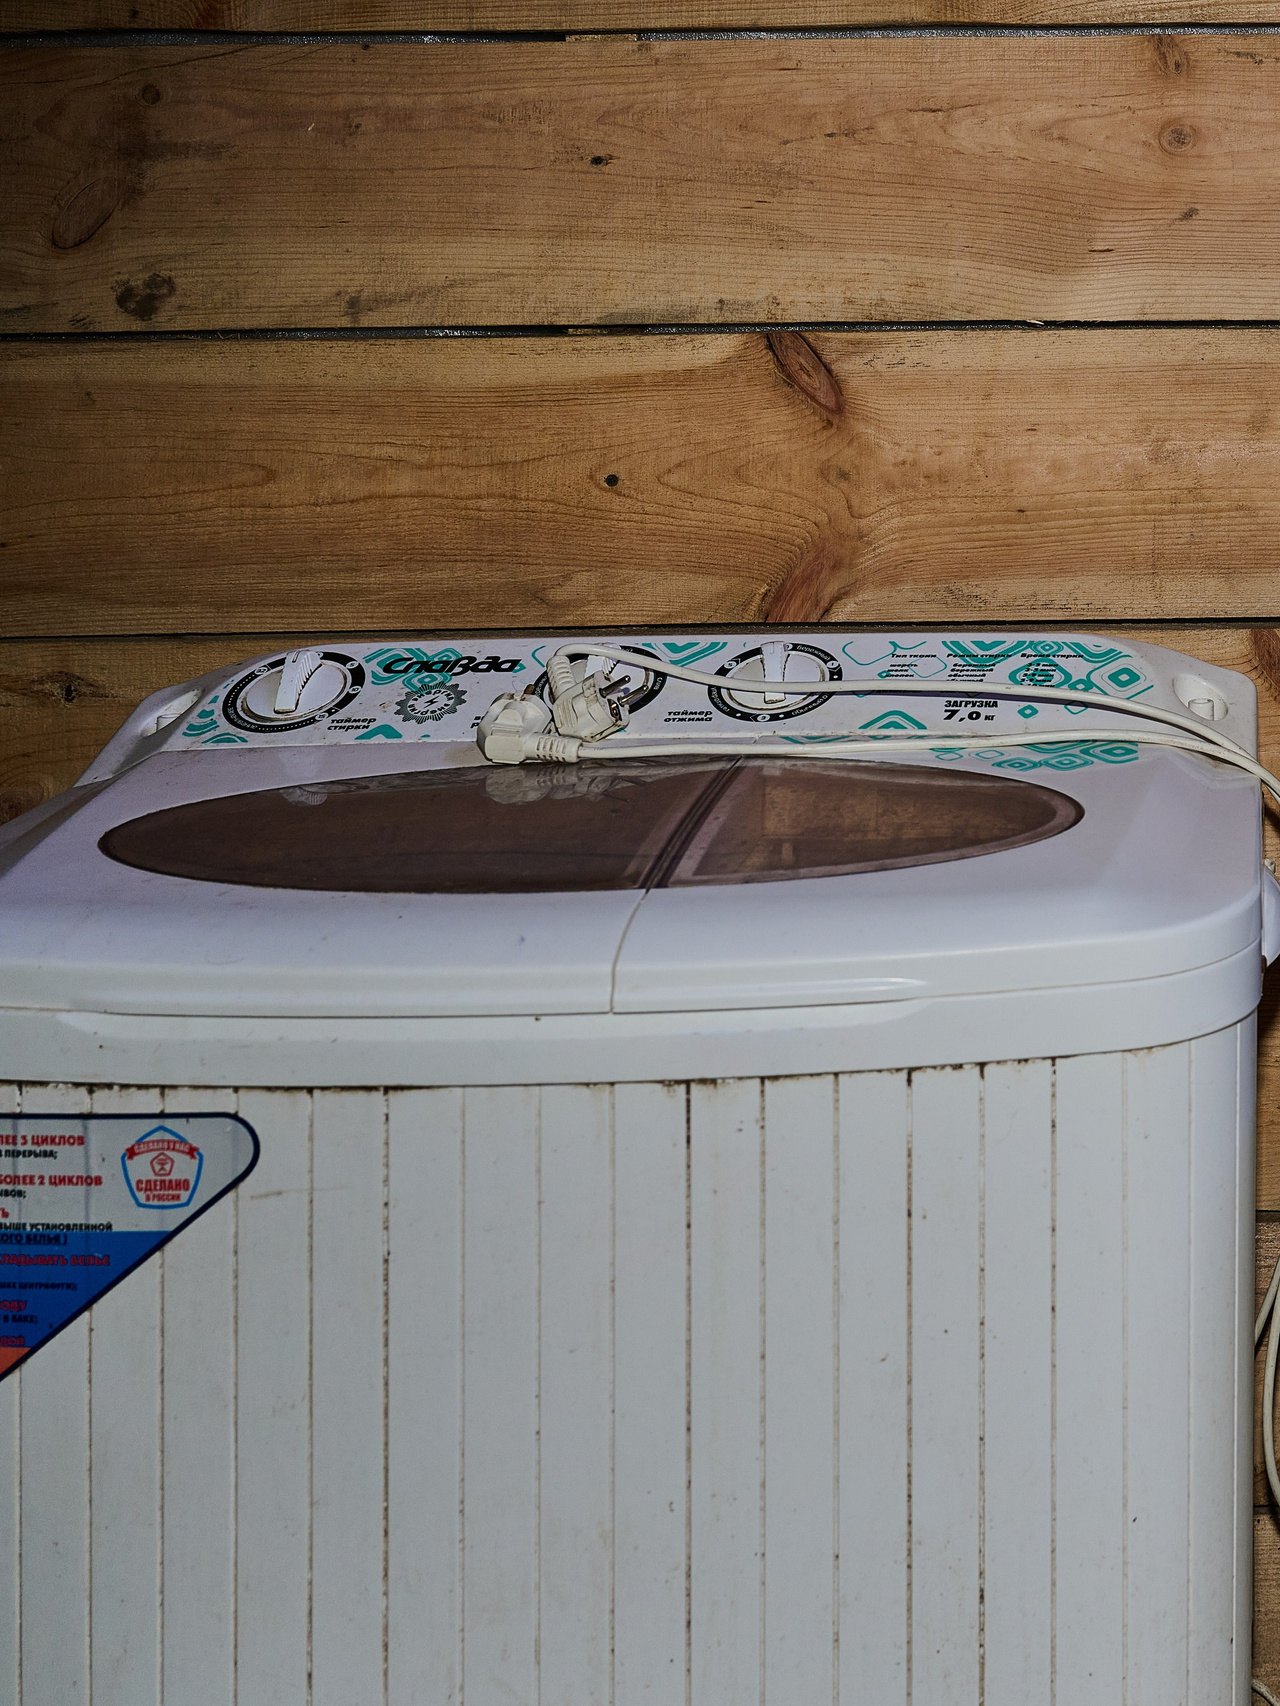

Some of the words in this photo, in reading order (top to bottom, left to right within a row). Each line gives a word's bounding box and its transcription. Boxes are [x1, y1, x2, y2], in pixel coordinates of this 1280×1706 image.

[944, 700, 998, 708] ЗАГРУЗКА
[943, 709, 981, 722] 7,0
[330, 717, 377, 725] таймер
[327, 723, 370, 732] стирки
[0, 1134, 18, 1146] ЛЕЕ
[21, 1135, 28, 1146] 3
[31, 1134, 85, 1147] ЦИКЛОВ
[38, 1174, 46, 1186] 2
[48, 1175, 103, 1187] ЦИКЛОВ
[135, 1178, 190, 1193] СДЕЛАНО
[29, 1221, 113, 1231] УСТАНОВЛЕННОЙ
[0, 1233, 23, 1243] ОГО
[0, 1254, 68, 1266] ЛАДЫВАТЬ
[71, 1255, 110, 1266] БЕЛЬЕ
[0, 1336, 25, 1346] ДОЙ
